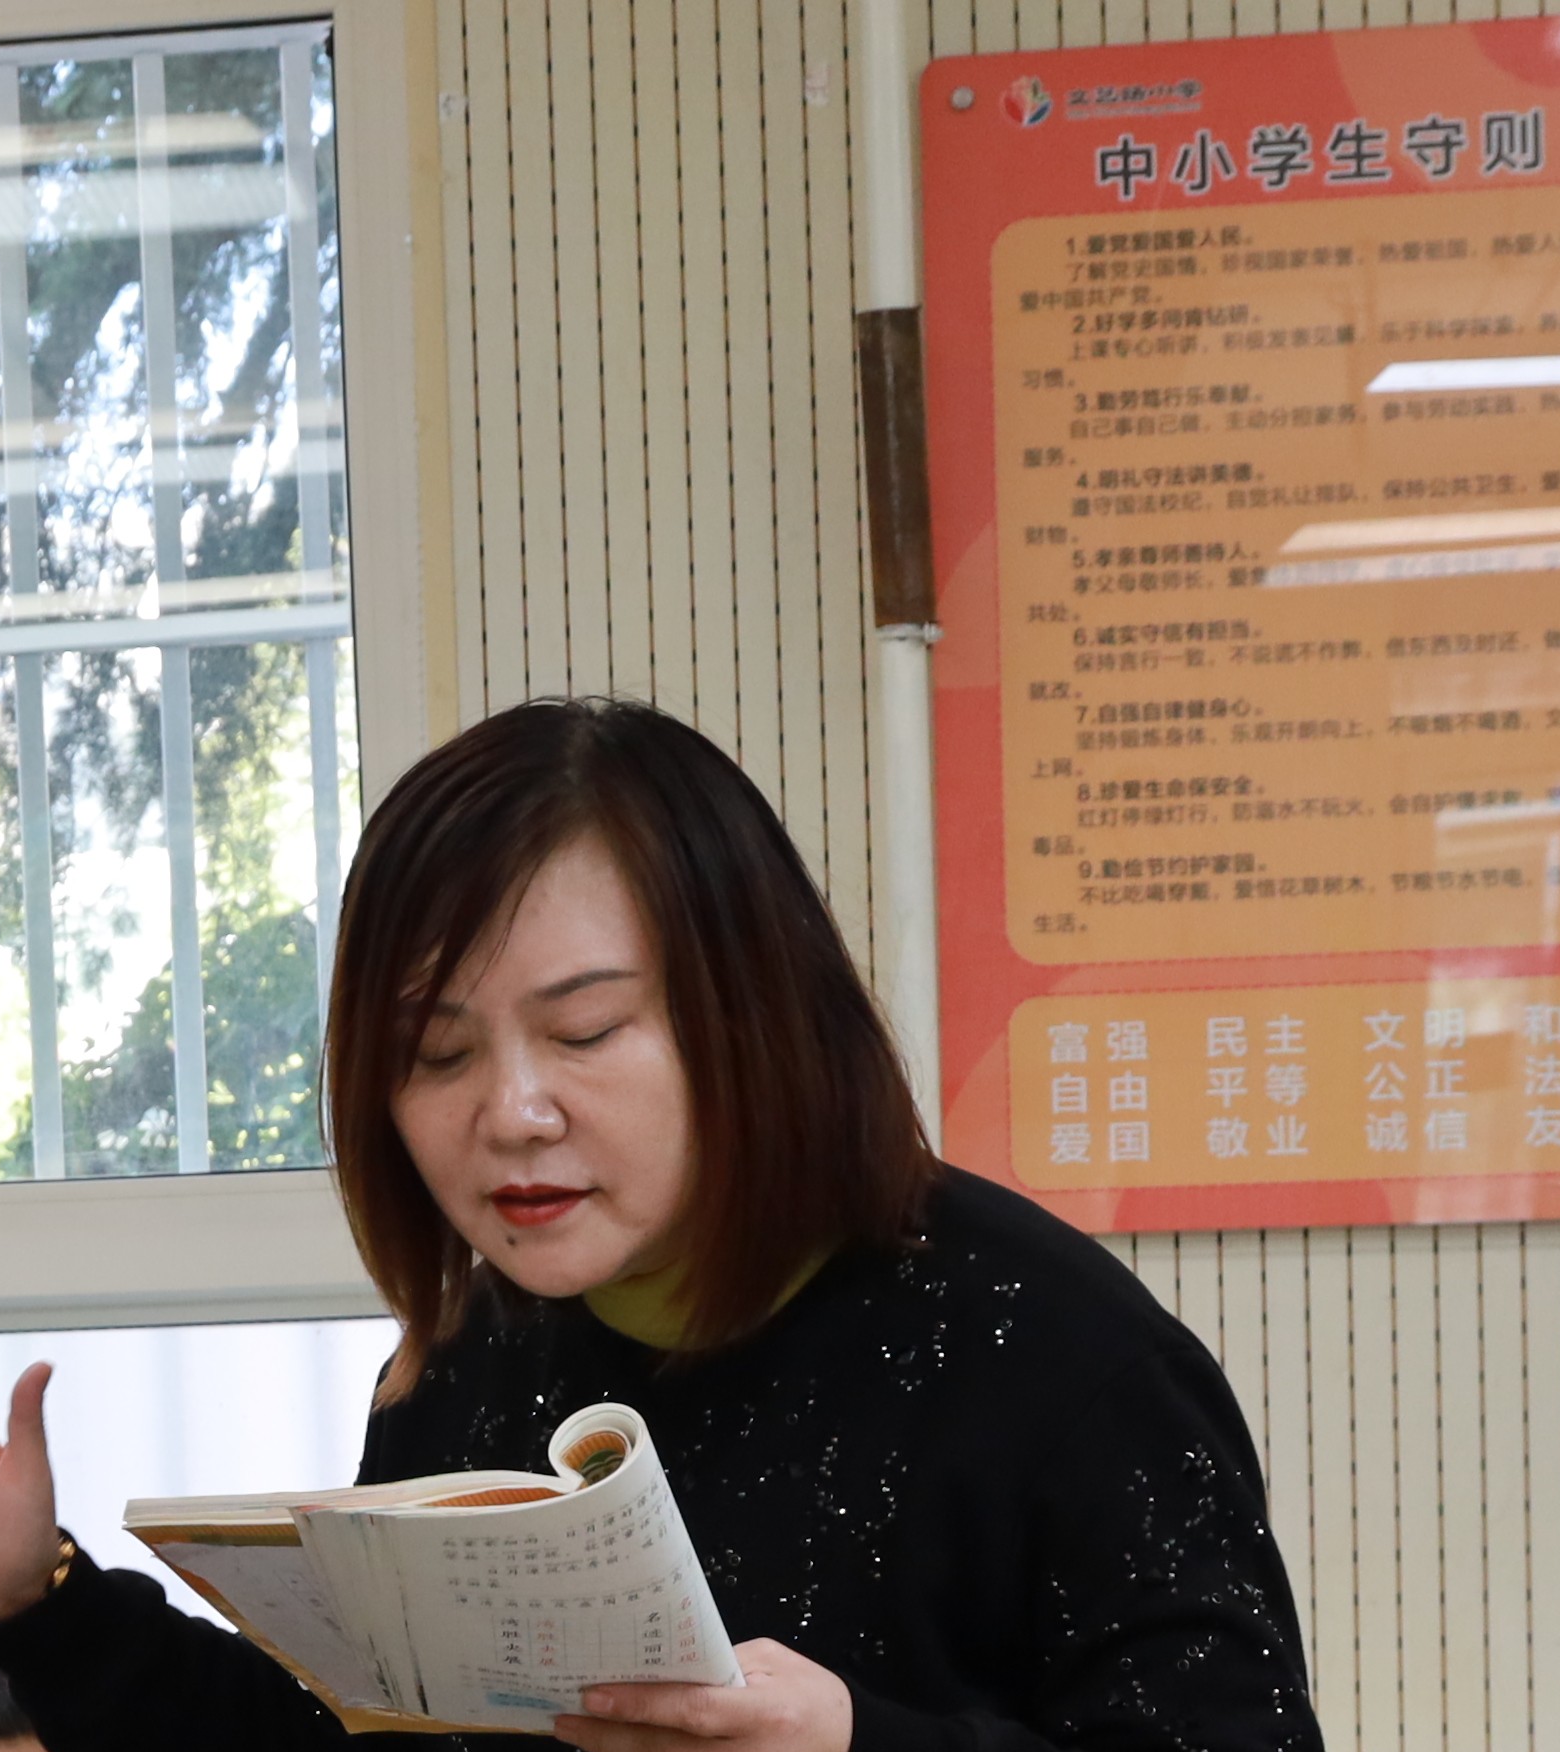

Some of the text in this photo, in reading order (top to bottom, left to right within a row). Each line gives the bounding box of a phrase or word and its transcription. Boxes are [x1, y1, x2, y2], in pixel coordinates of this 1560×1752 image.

[1094, 109, 1547, 202] 中小学生守则
[1047, 1020, 1151, 1066] 富强
[1205, 1013, 1308, 1061] 民主
[1364, 1009, 1467, 1054] 文明
[1049, 1070, 1151, 1115] 自由
[1206, 1064, 1308, 1110] 平等
[1365, 1058, 1467, 1103] 公正
[1049, 1120, 1151, 1165] 爱国
[1205, 1115, 1308, 1161] 敬业
[1366, 1110, 1468, 1154] 诚信
